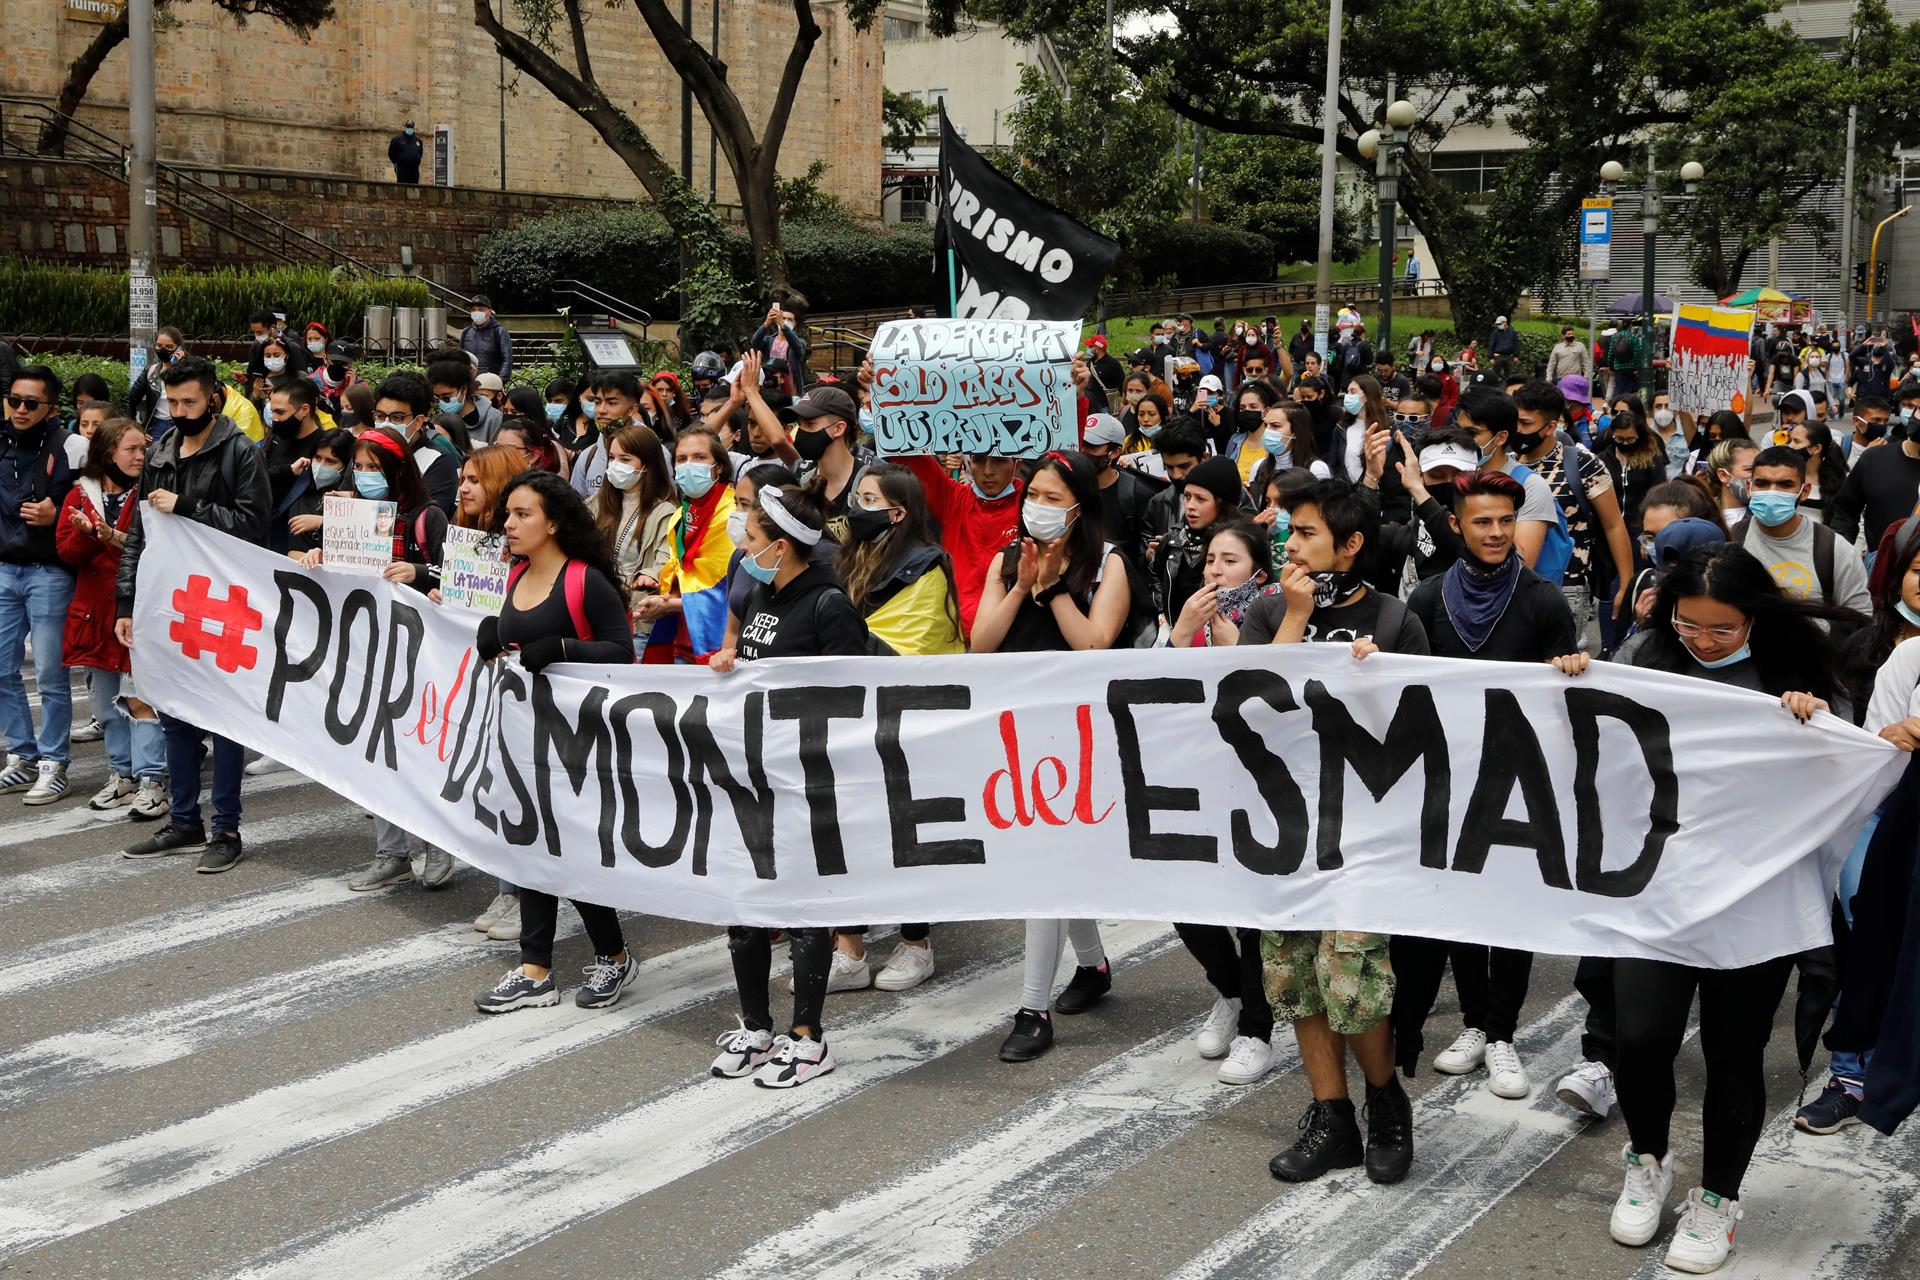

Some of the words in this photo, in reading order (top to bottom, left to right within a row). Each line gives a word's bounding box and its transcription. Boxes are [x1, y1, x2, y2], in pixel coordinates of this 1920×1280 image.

[873, 324, 925, 361] LA
[923, 322, 1075, 364] DERECHA
[872, 362, 948, 408] SOLO
[950, 363, 1042, 409] PARA
[932, 410, 1051, 455] PAJAZO
[360, 525, 370, 541] la
[448, 525, 464, 546] Que
[465, 574, 504, 596] TANGA
[751, 612, 779, 630] KEEP
[742, 625, 777, 645] CALM
[743, 645, 753, 657] I'M
[753, 648, 759, 659] A
[403, 646, 472, 762] el
[440, 656, 986, 880] DESMONTE
[983, 704, 1116, 829] del
[1107, 669, 1680, 897] ESMAD
